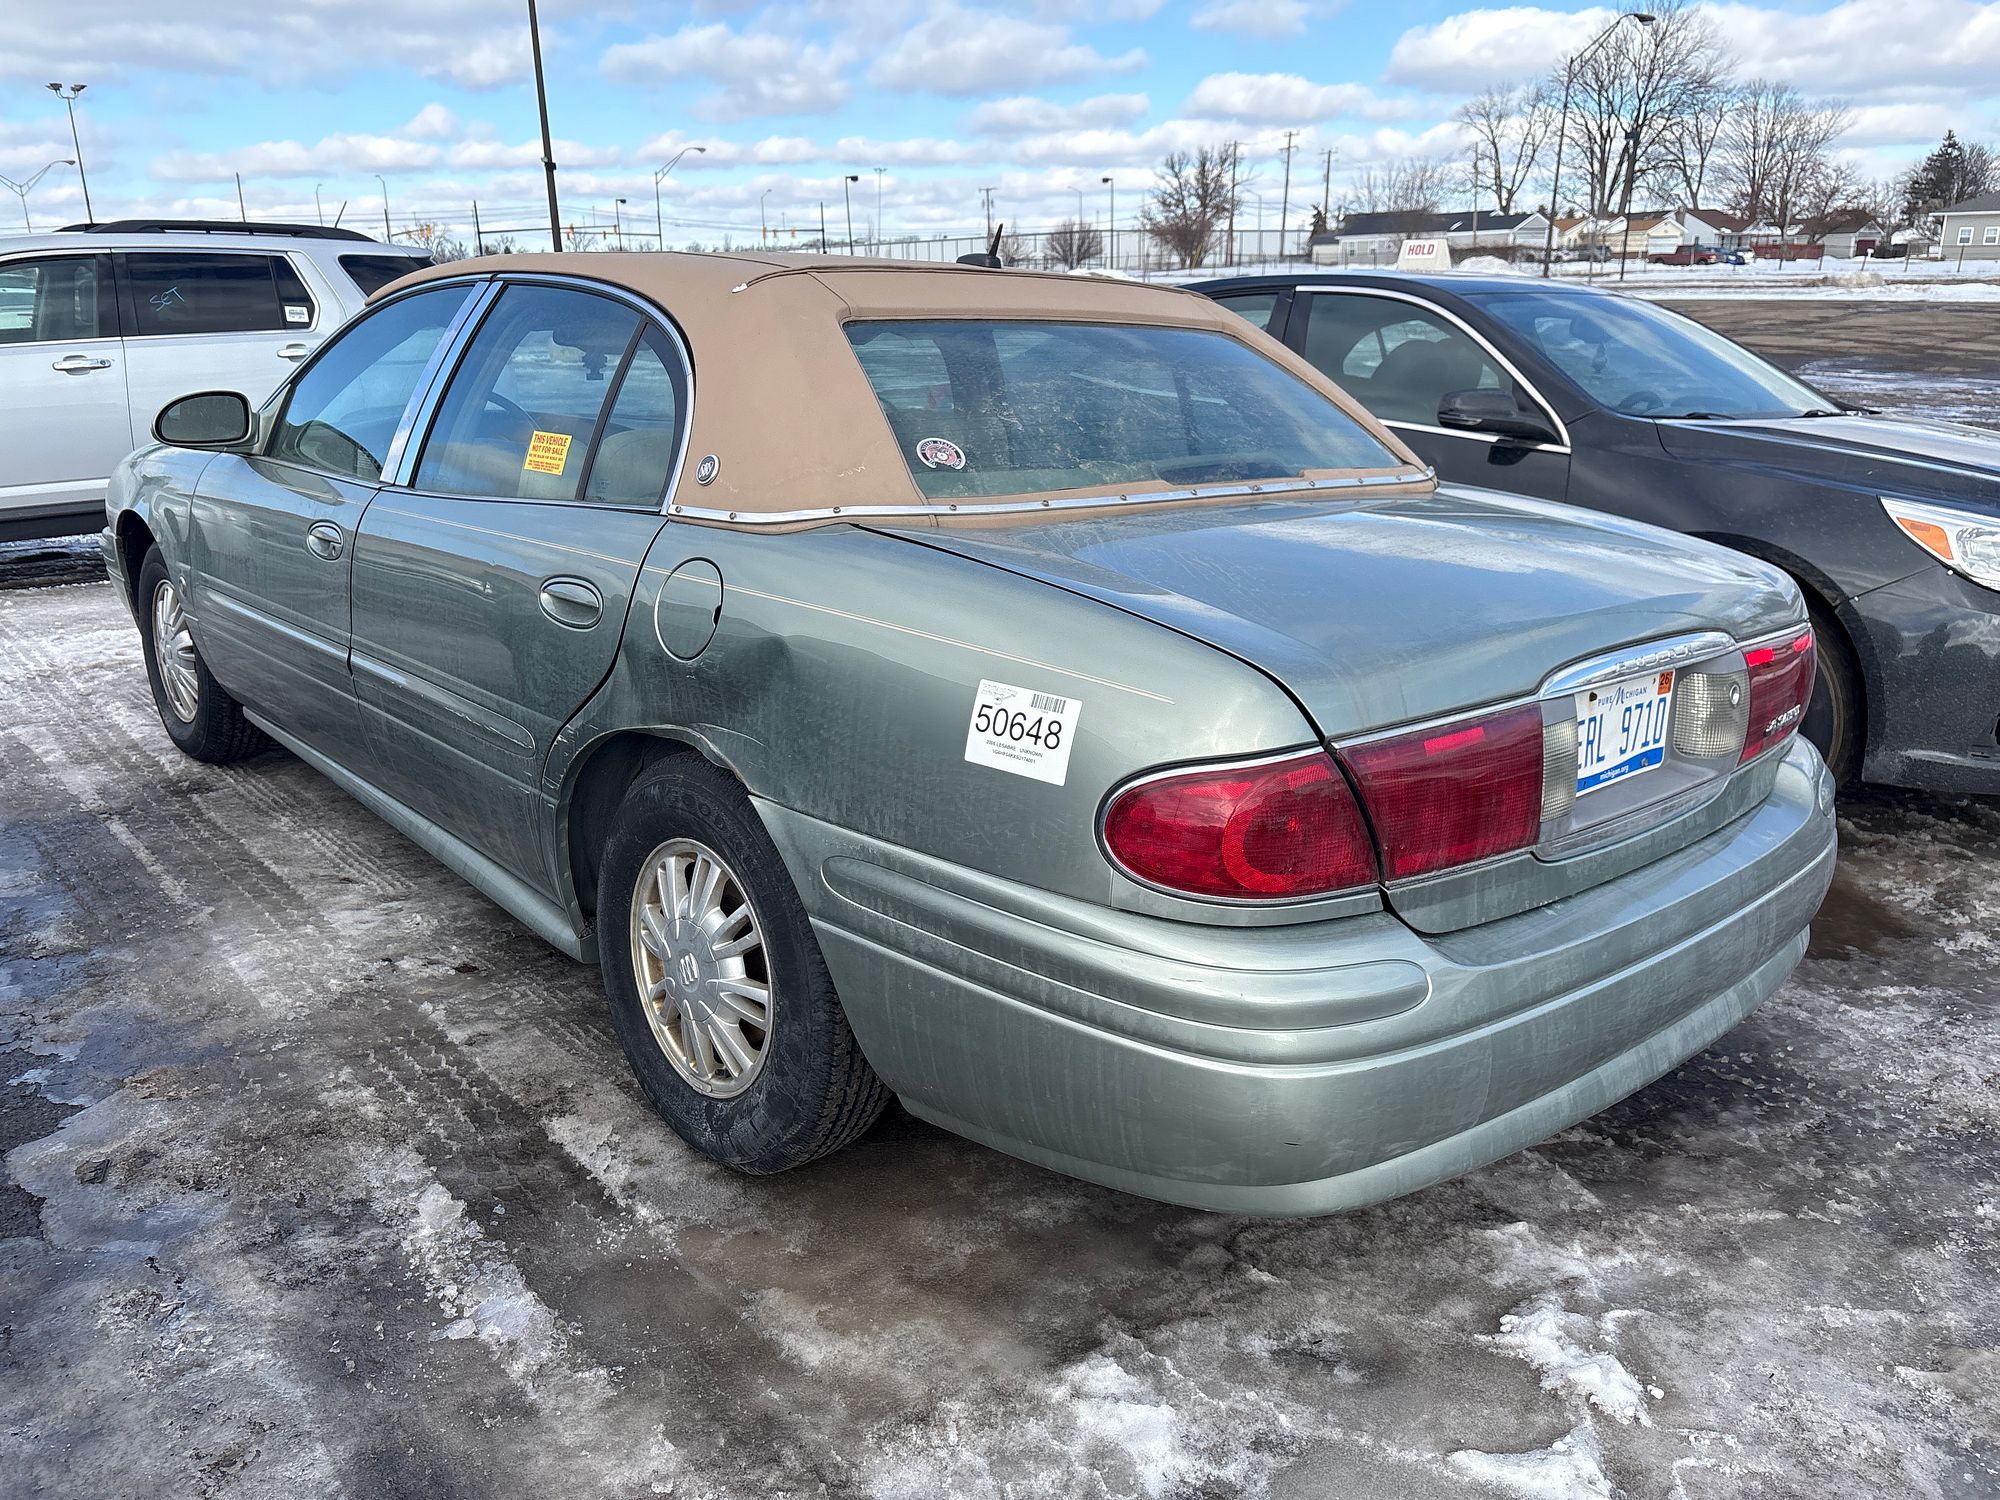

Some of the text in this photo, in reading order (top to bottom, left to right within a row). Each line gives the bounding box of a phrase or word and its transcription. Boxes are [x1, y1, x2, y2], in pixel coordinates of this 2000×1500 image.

[1407, 244, 1435, 256] HOLD
[150, 287, 184, 311] SET
[534, 433, 569, 447] THIS VEHICLE
[532, 444, 564, 456] NOT FOR SALE
[1660, 672, 1670, 686] 26
[1598, 686, 1648, 711] PURE MICHIGAN
[975, 704, 1062, 750] 50648
[1619, 696, 1667, 756] 9710
[996, 741, 1016, 751] LESABRE
[1019, 748, 1043, 758] UNKNOWN
[1600, 764, 1629, 780] michigan.org
